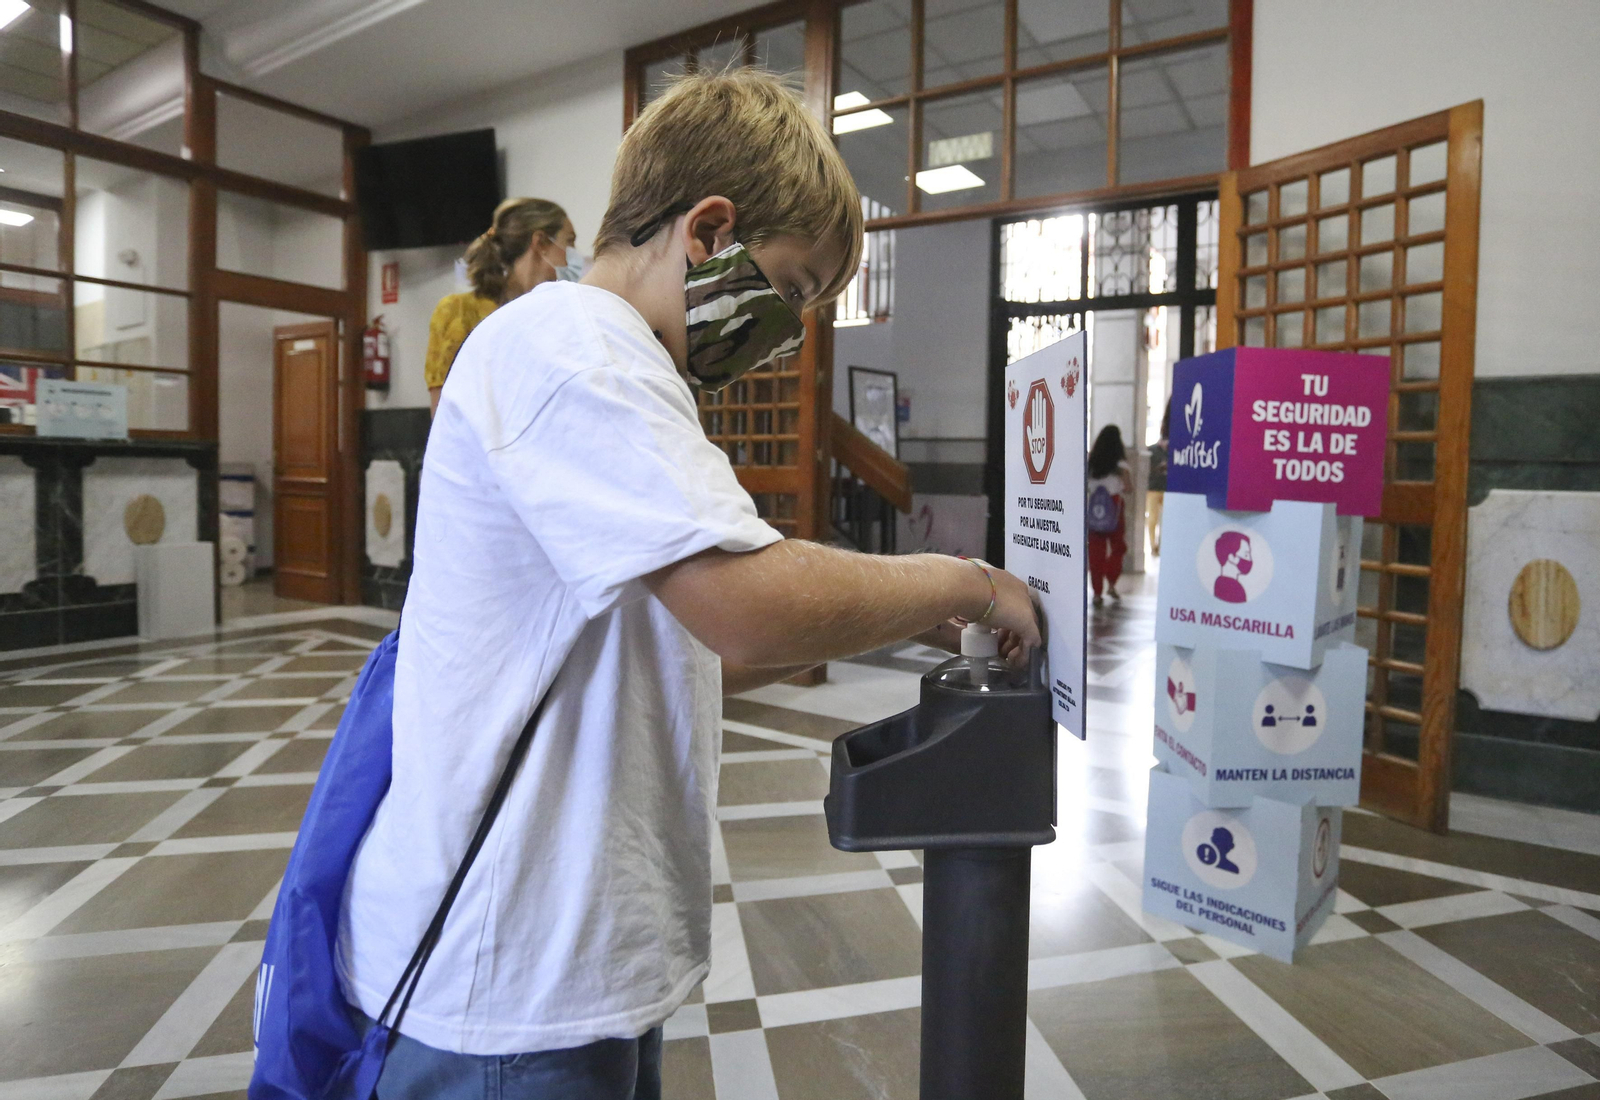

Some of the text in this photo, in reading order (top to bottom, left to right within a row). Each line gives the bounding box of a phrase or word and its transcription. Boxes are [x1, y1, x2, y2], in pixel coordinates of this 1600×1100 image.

[1301, 373, 1329, 397] TU
[1251, 399, 1372, 427] SEGURIDAD
[1031, 437, 1046, 454] STOP
[1263, 429, 1358, 455] ES LA DE
[1272, 458, 1345, 483] TODOS
[1018, 497, 1064, 514] POR TU SEGURIDAD,
[1020, 516, 1061, 533] POR LA NUESTRA.
[1013, 533, 1071, 558] HIGIENIZATE LAS MANOS.
[1028, 576, 1050, 594] GRACIAS.
[1170, 607, 1196, 623] USA
[1200, 611, 1295, 639] MASCARILLA
[1215, 767, 1355, 781] MANTEN LA DISTANCIA
[1151, 877, 1287, 932] SIGUE LAS INDICACIONES
[1176, 899, 1256, 936] DEL PERSONAL
